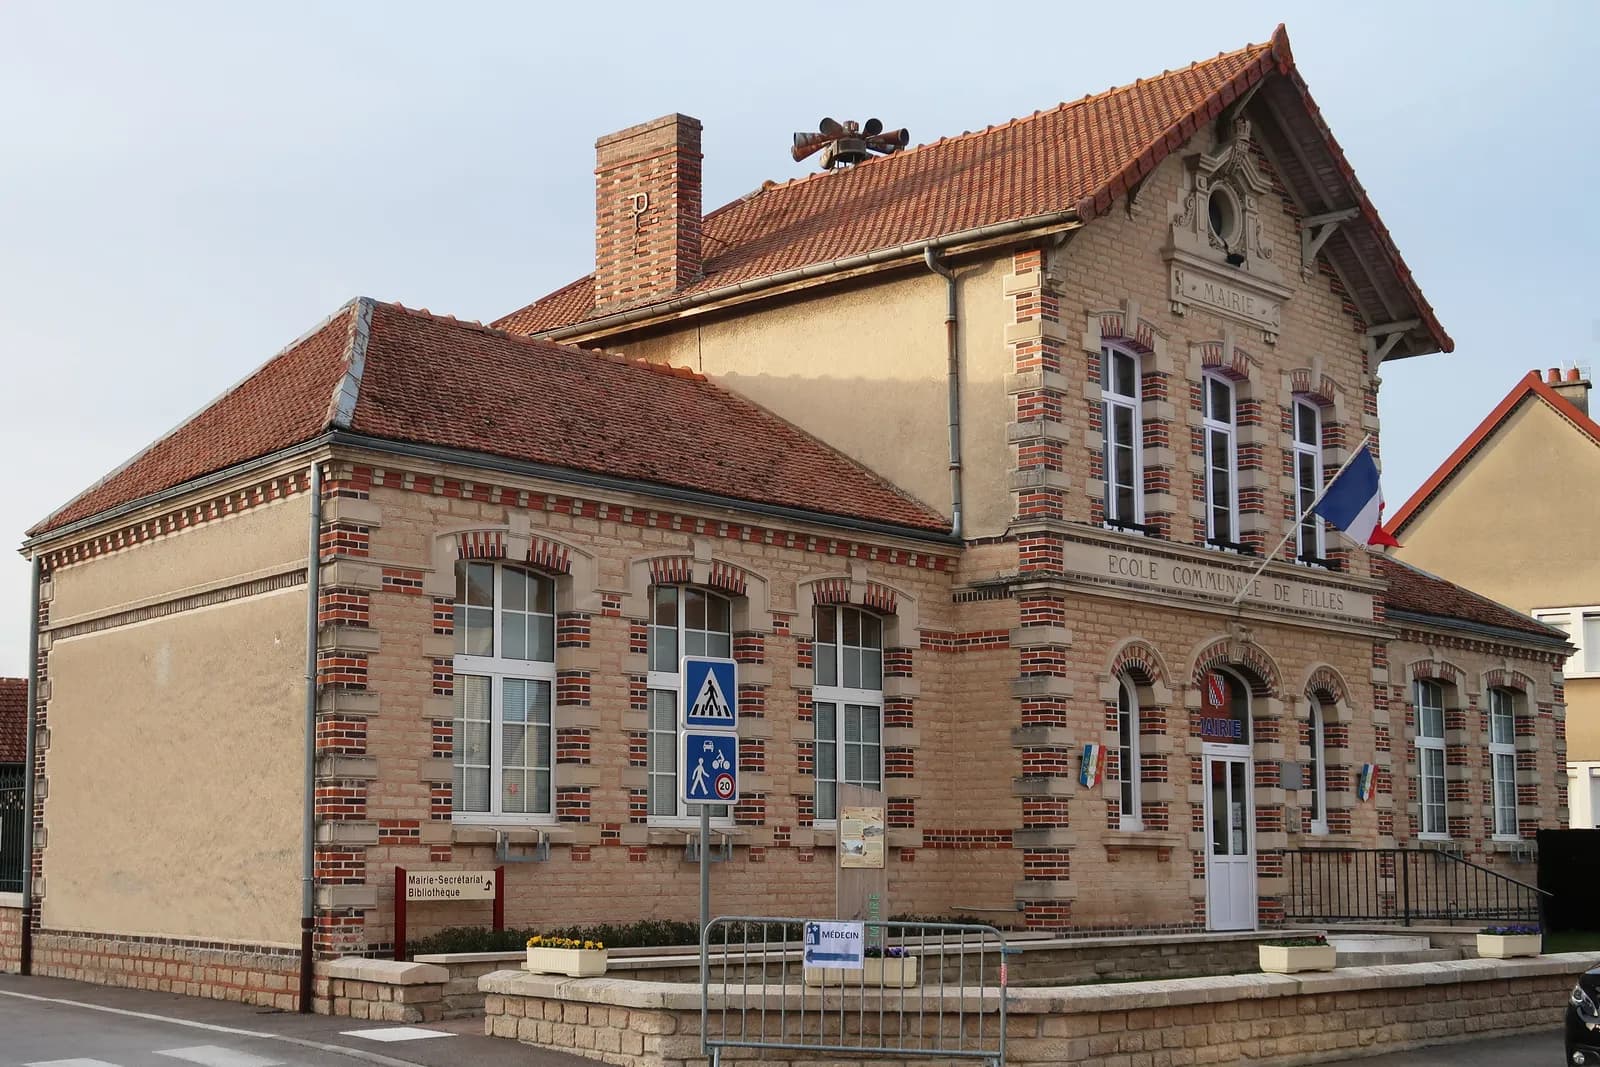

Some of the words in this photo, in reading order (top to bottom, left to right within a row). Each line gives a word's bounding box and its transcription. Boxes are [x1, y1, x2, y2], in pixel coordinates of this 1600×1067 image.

[1203, 283, 1254, 315] MAIRIE
[1108, 554, 1159, 581] ECOLE
[1172, 566, 1262, 598] COMMUNALE
[1274, 583, 1291, 602] DE
[1302, 589, 1344, 611] FILLES
[720, 782, 730, 790] 20
[408, 875, 483, 885] Mairie-Secrétariat
[408, 887, 460, 898] Bibliothèque
[821, 930, 859, 939] MÉDECIN
